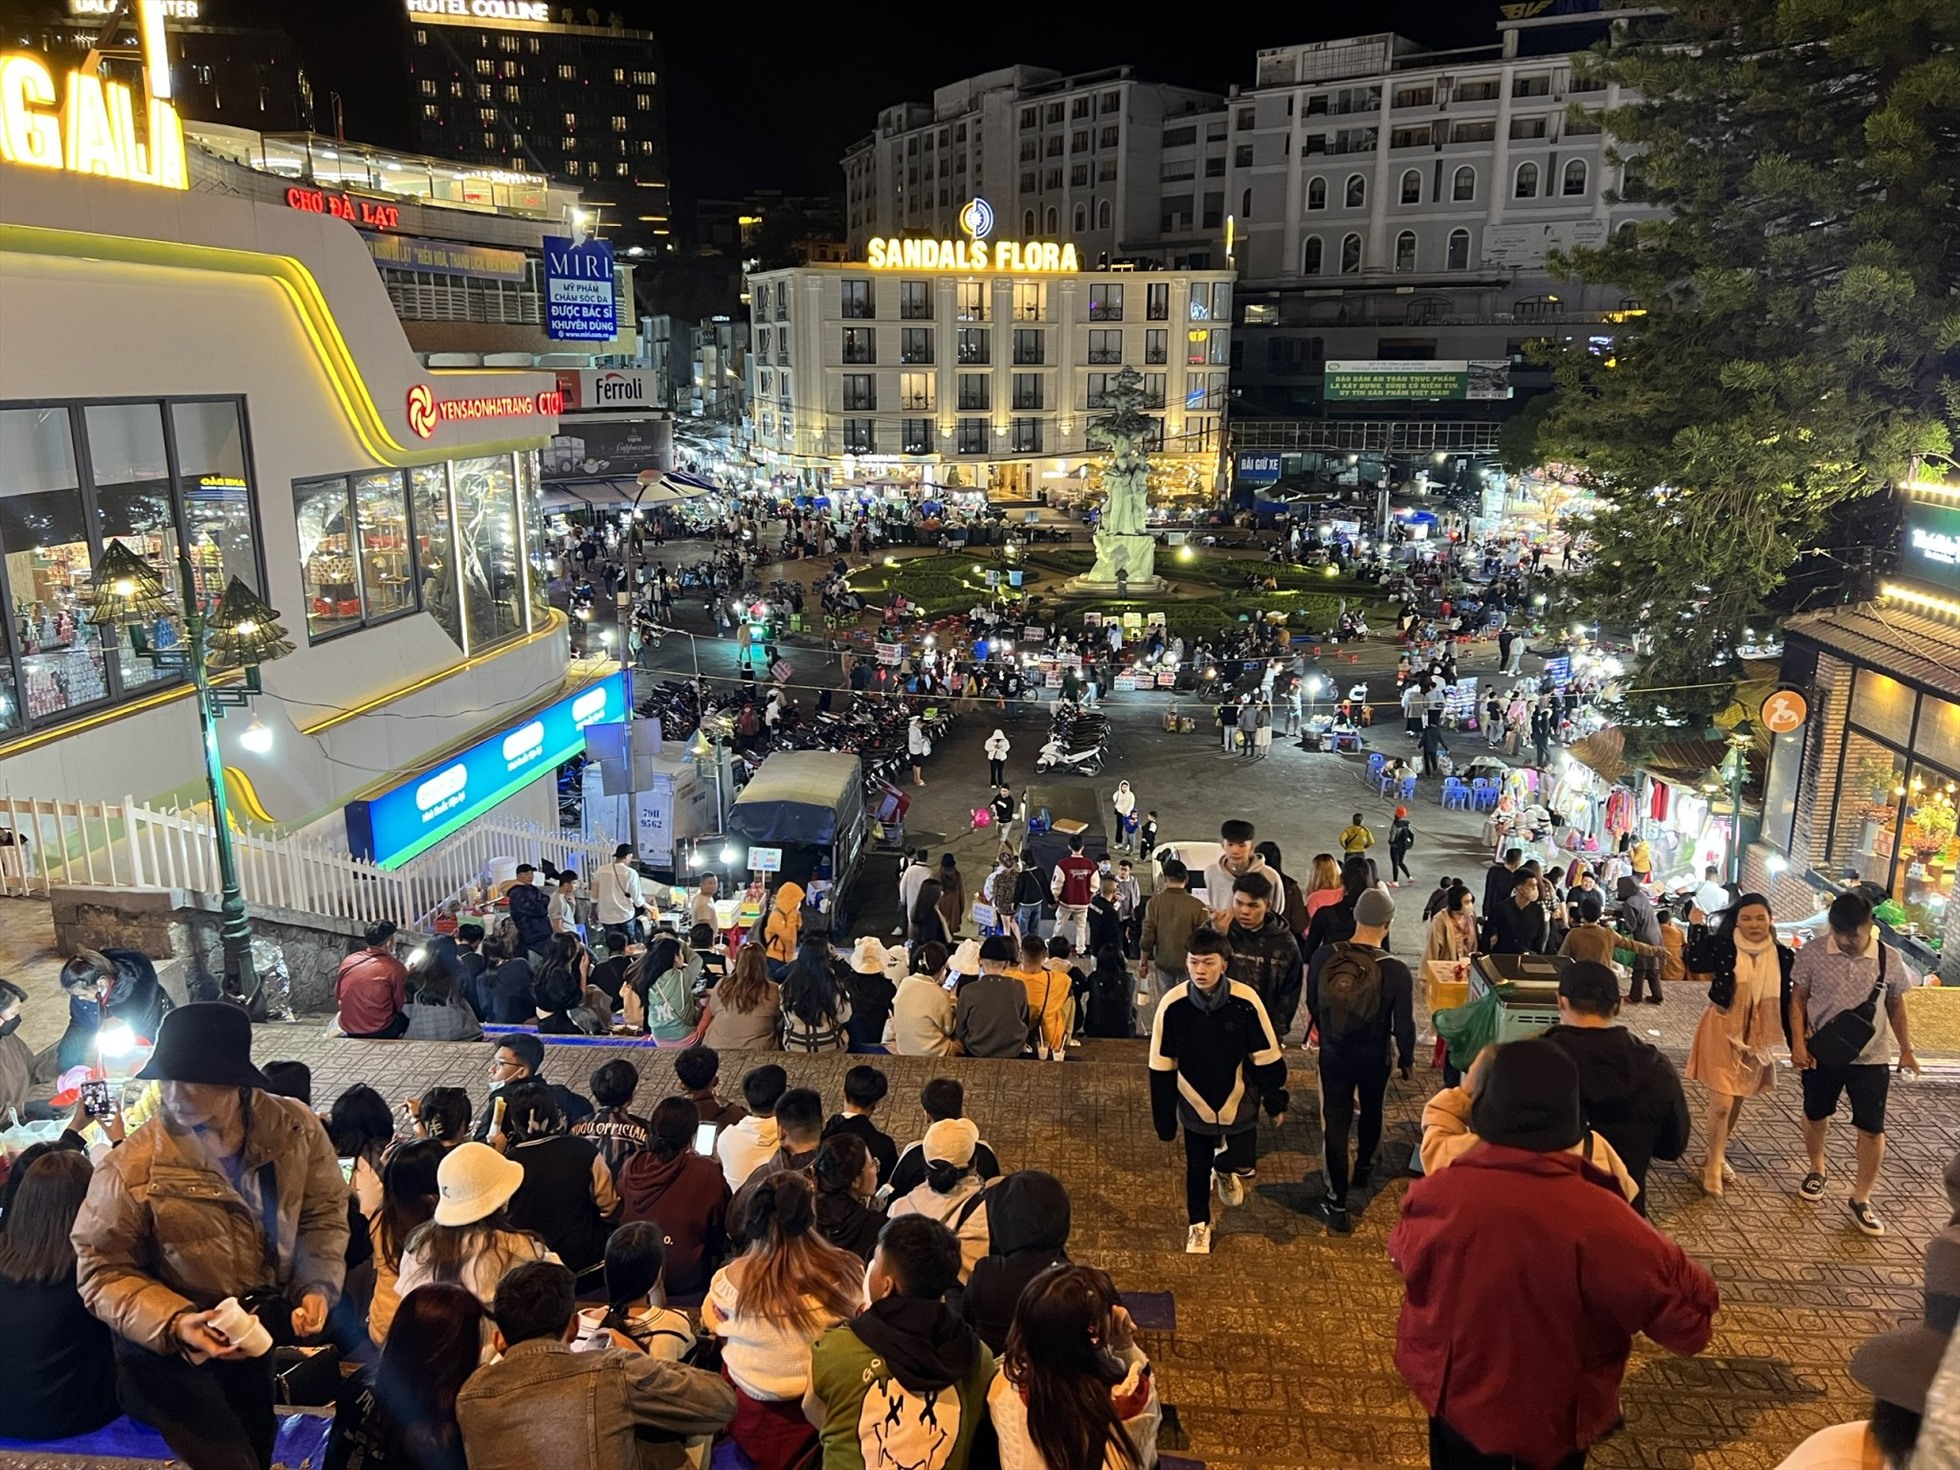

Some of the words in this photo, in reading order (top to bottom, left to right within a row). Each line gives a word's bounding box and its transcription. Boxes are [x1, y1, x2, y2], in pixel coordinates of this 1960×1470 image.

[408, 0, 470, 15] HOTEL
[472, 0, 549, 21] COLLINE
[287, 186, 324, 214] CHỢ
[328, 189, 356, 221] ĐÀ
[361, 202, 399, 231] LẠT
[868, 237, 988, 270] SANDALS
[995, 240, 1079, 272] FLORA
[550, 252, 609, 279] MIRI
[563, 282, 575, 291] MỸ
[576, 282, 599, 293] PHẨM
[579, 293, 595, 303] SÓC
[597, 295, 608, 303] DA
[551, 304, 580, 319] ĐƯỢC
[582, 304, 601, 318] BÁC
[603, 305, 613, 318] SĨ
[551, 318, 588, 330] KHUYÊN
[589, 319, 614, 331] DÙNG
[596, 374, 642, 404] Ferroli
[439, 395, 533, 421] YENSAONHATRANG
[1241, 457, 1254, 470] BÃI
[1255, 457, 1268, 470] GIỮ
[1269, 459, 1279, 470] XE
[641, 819, 662, 829] 9562
